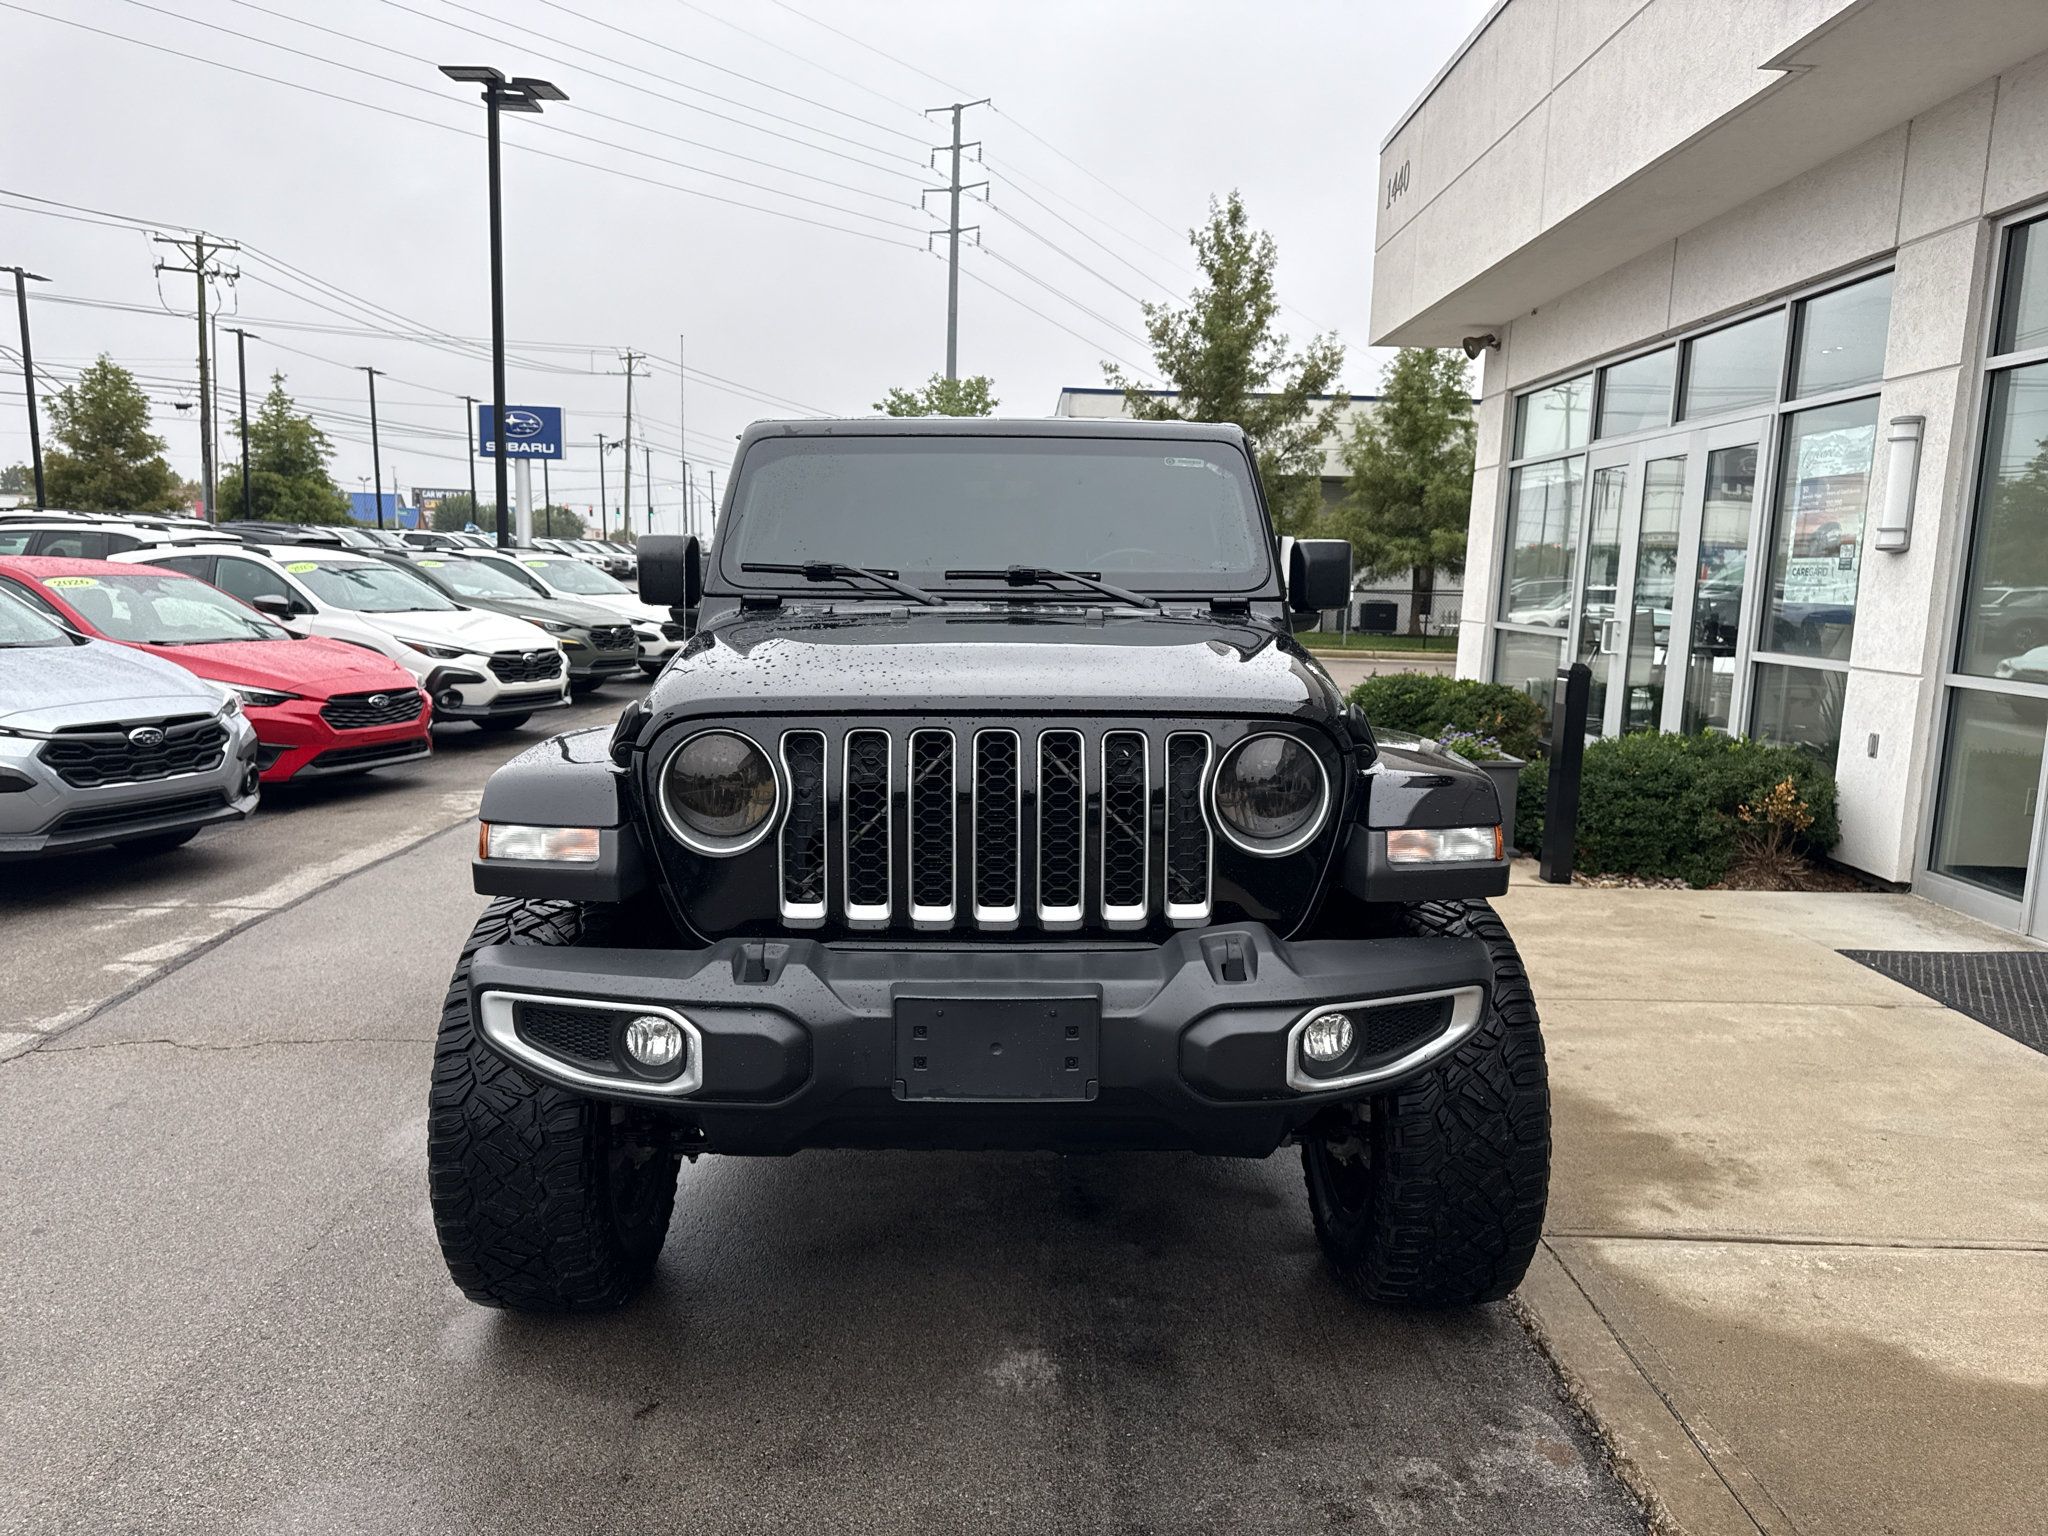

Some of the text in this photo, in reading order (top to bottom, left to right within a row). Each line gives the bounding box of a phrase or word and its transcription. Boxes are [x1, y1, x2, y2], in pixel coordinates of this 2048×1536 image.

[1386, 159, 1410, 210] 1440
[485, 441, 555, 454] SBARU
[1792, 567, 1829, 577] CAREGARD
